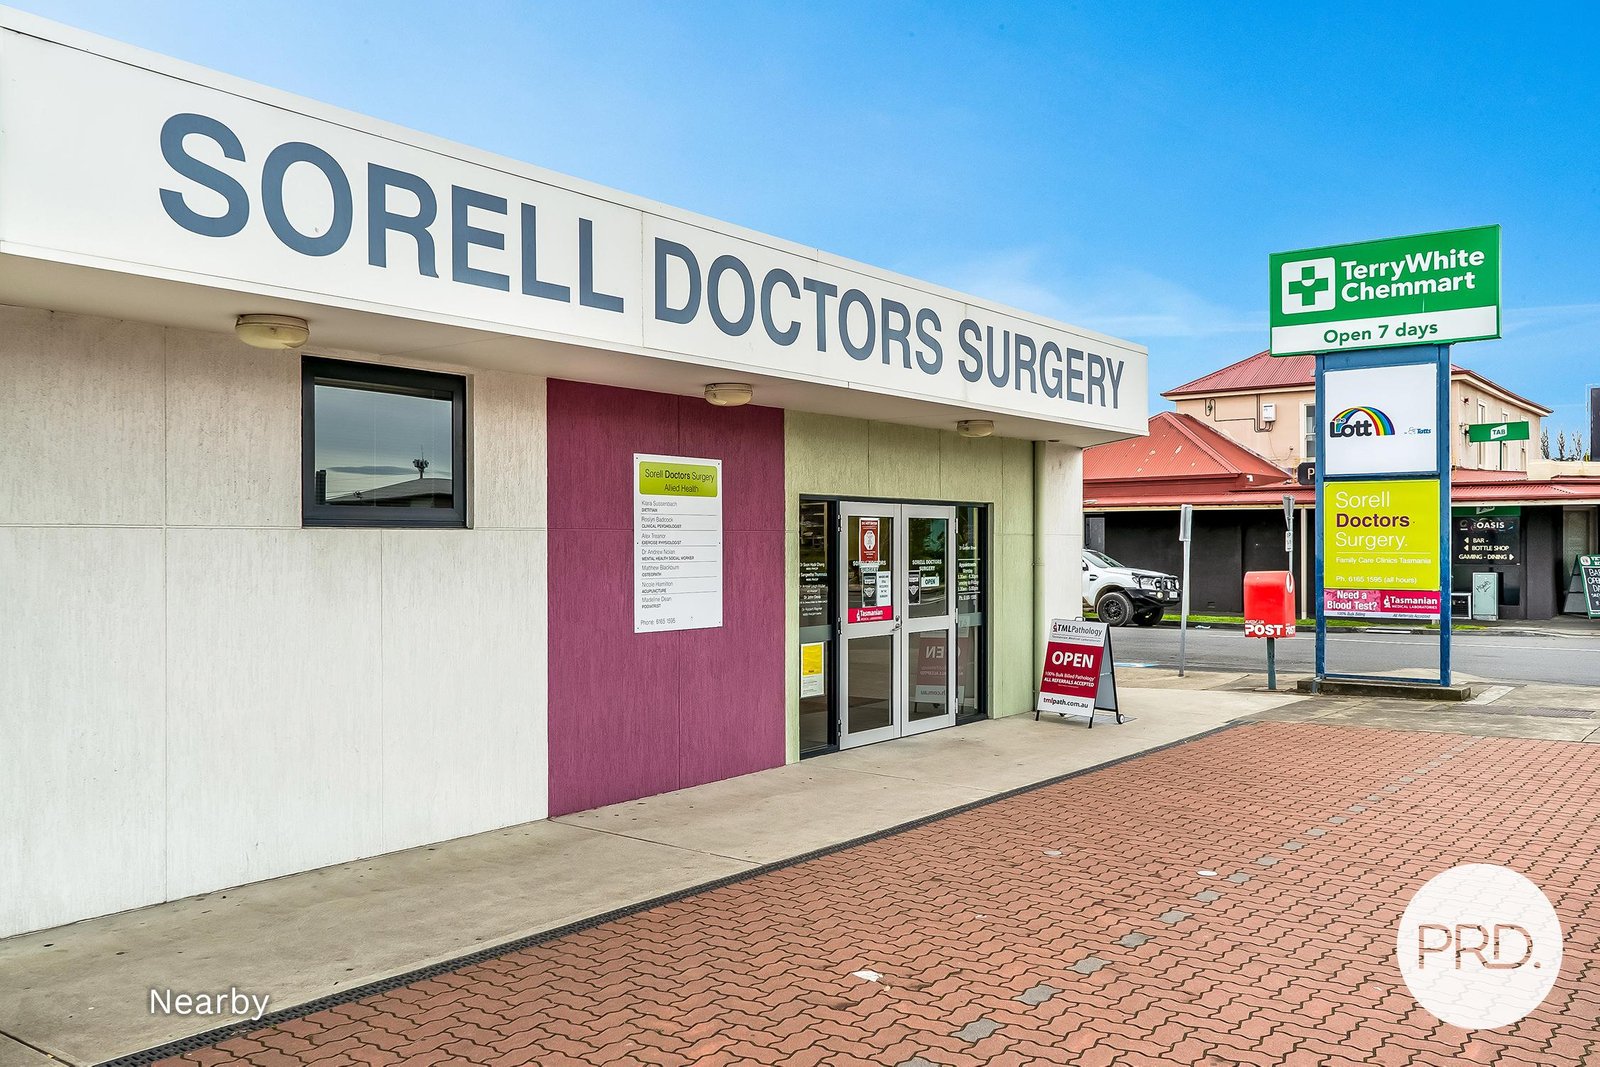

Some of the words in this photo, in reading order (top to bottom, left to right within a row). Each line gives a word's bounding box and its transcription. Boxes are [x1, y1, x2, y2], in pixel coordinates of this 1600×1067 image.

[159, 113, 624, 313] SORELL
[655, 237, 943, 375] DOCTORS
[959, 319, 1124, 409] SURGERY
[1341, 249, 1485, 281] TerryWhite
[1341, 271, 1476, 302] Chemmart
[1323, 329, 1371, 346] Open
[1378, 325, 1389, 338] 7
[1395, 322, 1438, 340] days
[1330, 420, 1372, 438] Lott
[645, 469, 663, 478] Sorell
[665, 470, 690, 479] Doctors
[692, 472, 714, 483] Surgery
[1336, 491, 1390, 508] Sorell
[1336, 513, 1410, 528] Doctors
[1336, 532, 1408, 550] Surgery.
[1336, 590, 1358, 599] Need
[1390, 596, 1438, 604] Tasmanian
[1327, 601, 1352, 610] Blood
[1354, 601, 1377, 610] Test?
[1245, 624, 1283, 635] POST
[1052, 651, 1094, 668] OPEN
[1044, 697, 1088, 708] tmlpath.com.au
